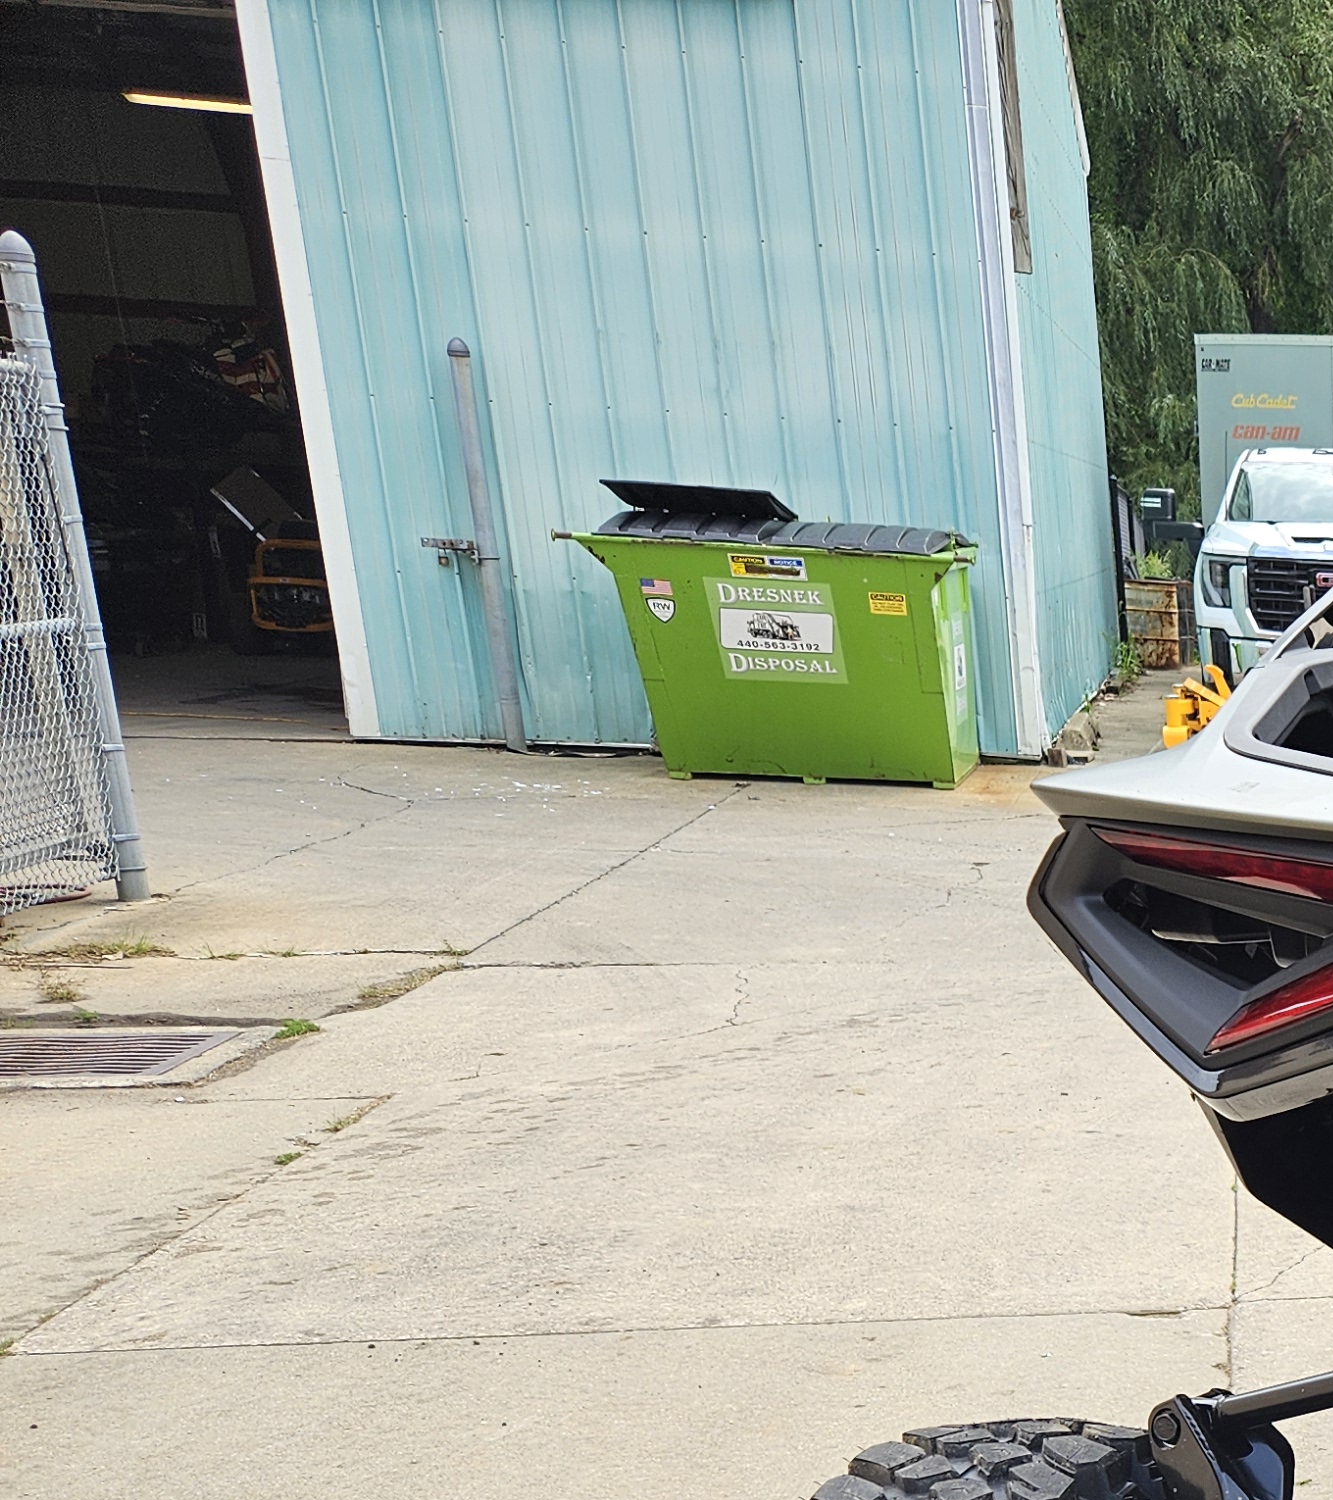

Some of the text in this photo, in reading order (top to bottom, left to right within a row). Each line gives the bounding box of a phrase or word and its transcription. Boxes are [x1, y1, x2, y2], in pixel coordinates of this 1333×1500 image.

[1231, 424, 1301, 441] can-am
[716, 582, 825, 606] DRESNEK
[737, 640, 820, 651] 440-563-3192
[727, 652, 839, 674] DISPOSAL
